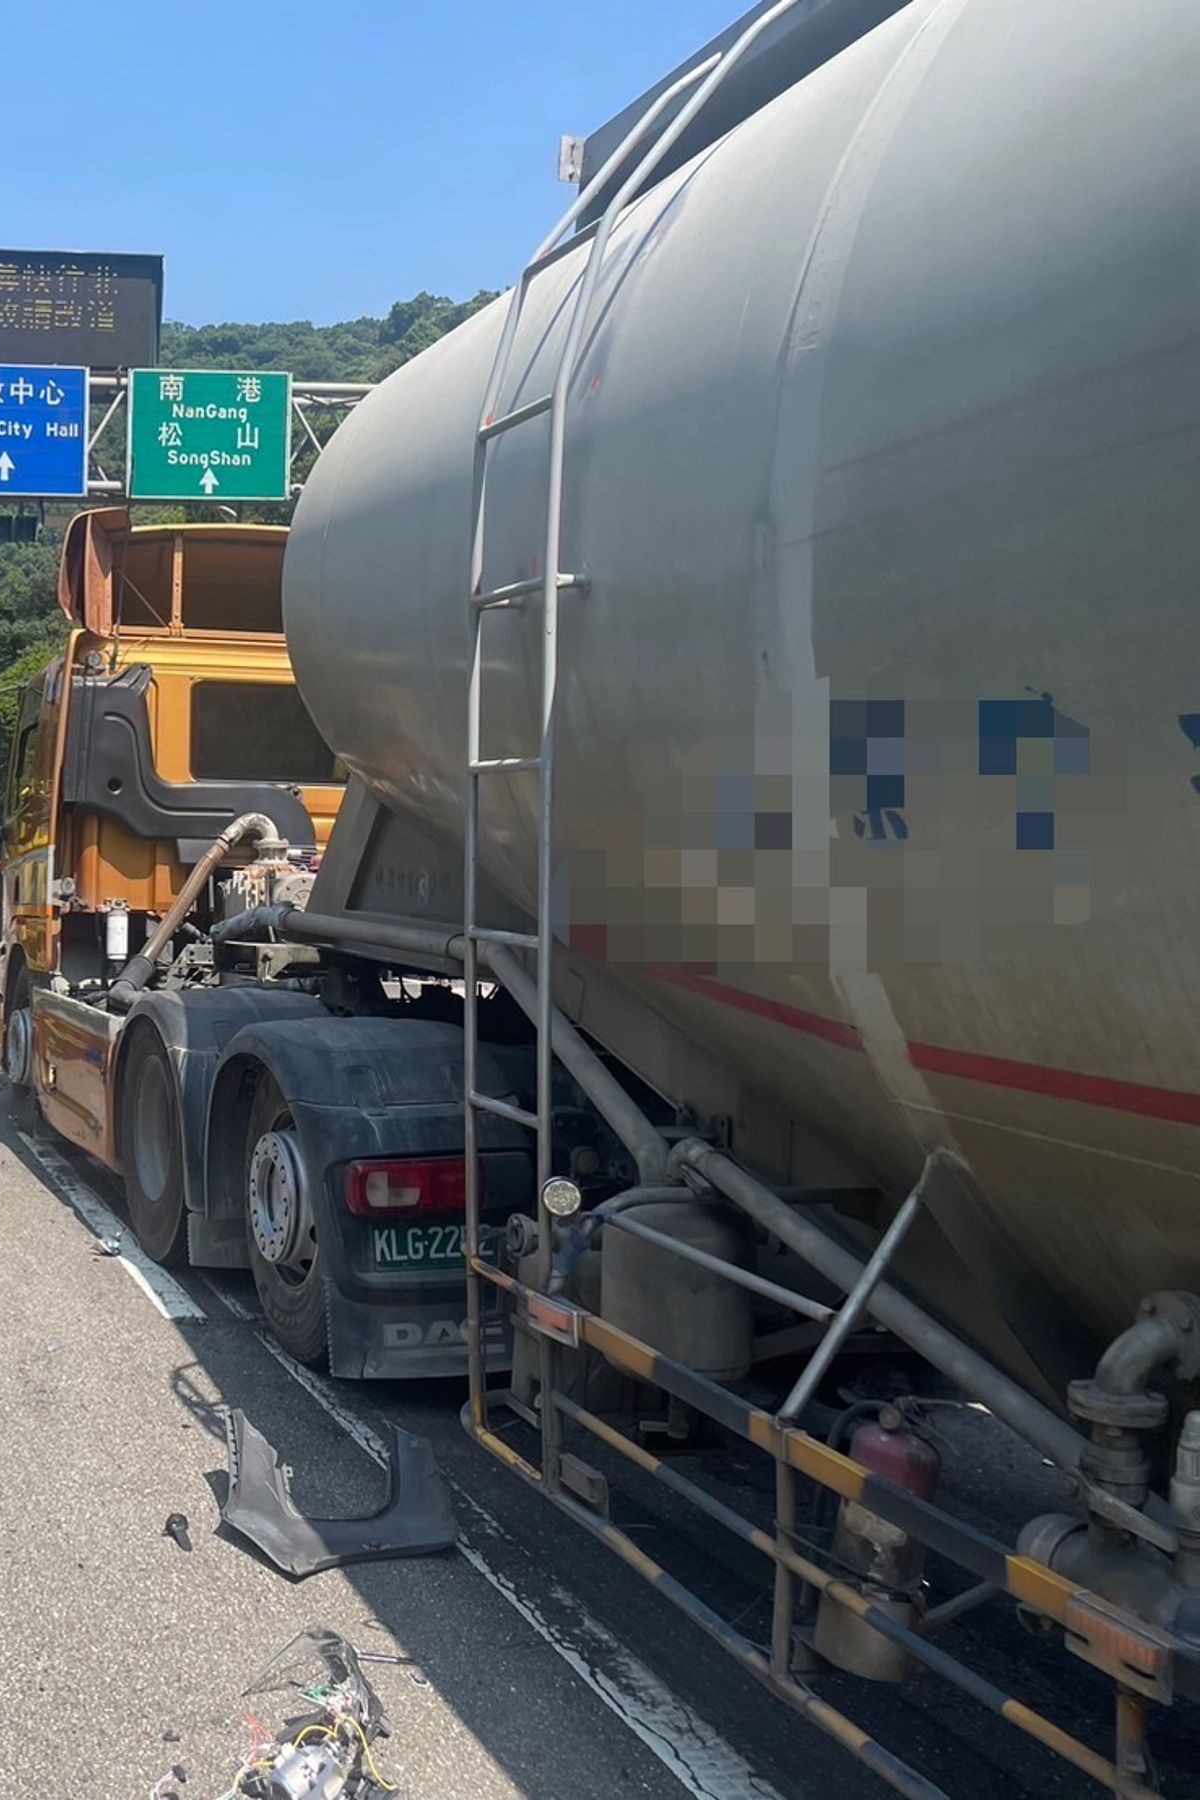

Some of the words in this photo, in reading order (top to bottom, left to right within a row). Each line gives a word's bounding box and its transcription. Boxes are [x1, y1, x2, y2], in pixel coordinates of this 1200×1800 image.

[172, 403, 247, 423] NanGang
[46, 422, 79, 437] Hall
[167, 450, 251, 468] SongShan
